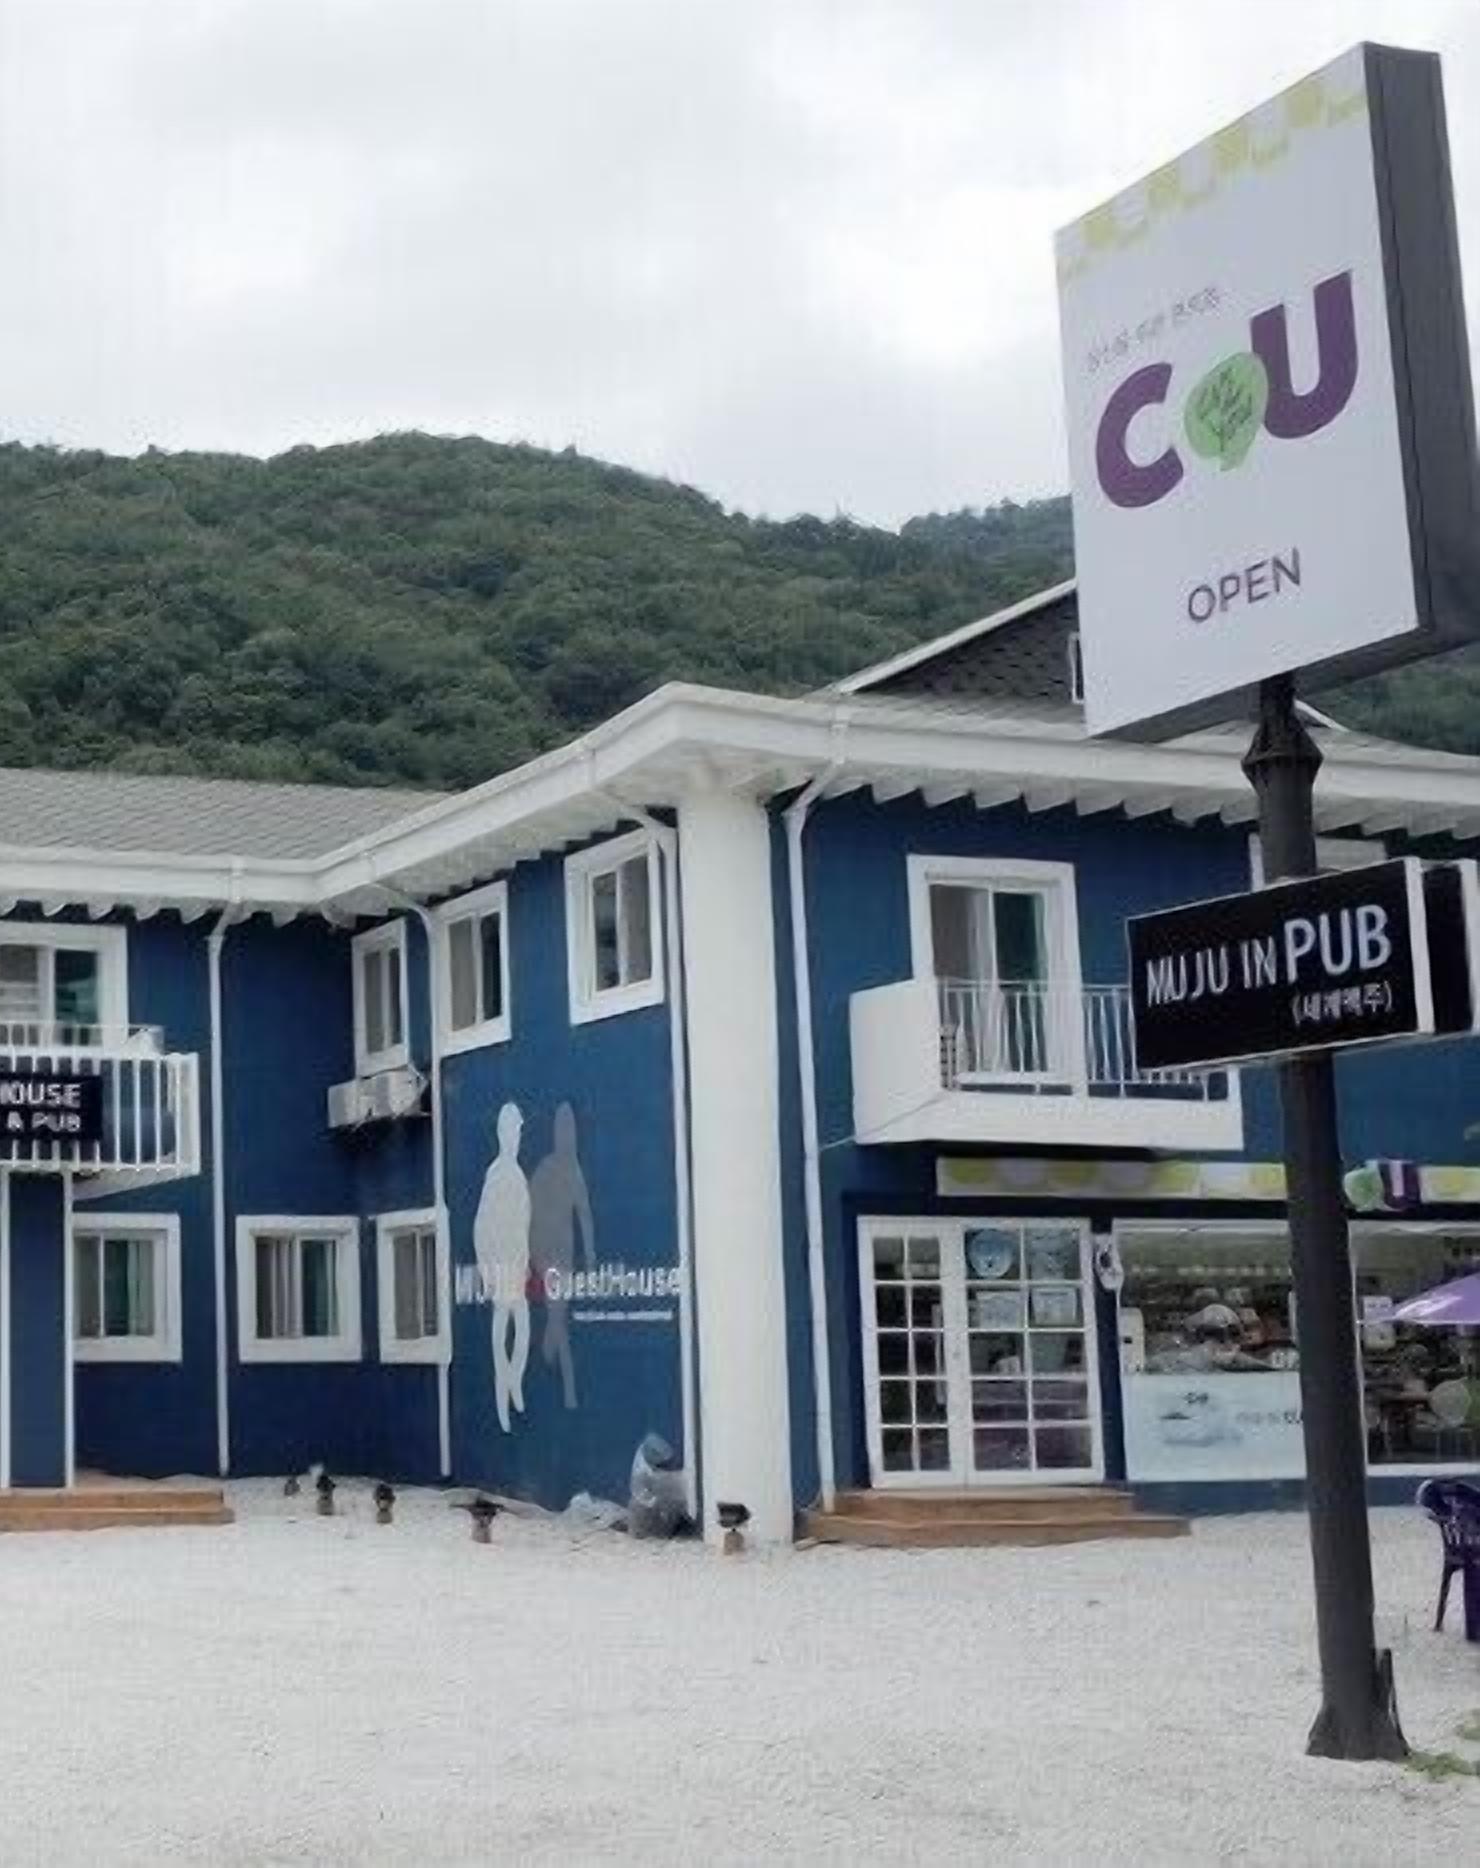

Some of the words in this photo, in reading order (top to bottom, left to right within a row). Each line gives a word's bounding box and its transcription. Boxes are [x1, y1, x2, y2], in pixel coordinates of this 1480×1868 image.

[1187, 546, 1302, 624] OPEN
[1146, 946, 1230, 1008] MUJU
[1239, 934, 1277, 989] IN
[1283, 903, 1392, 984] PUB
[31, 1111, 82, 1133] PUB
